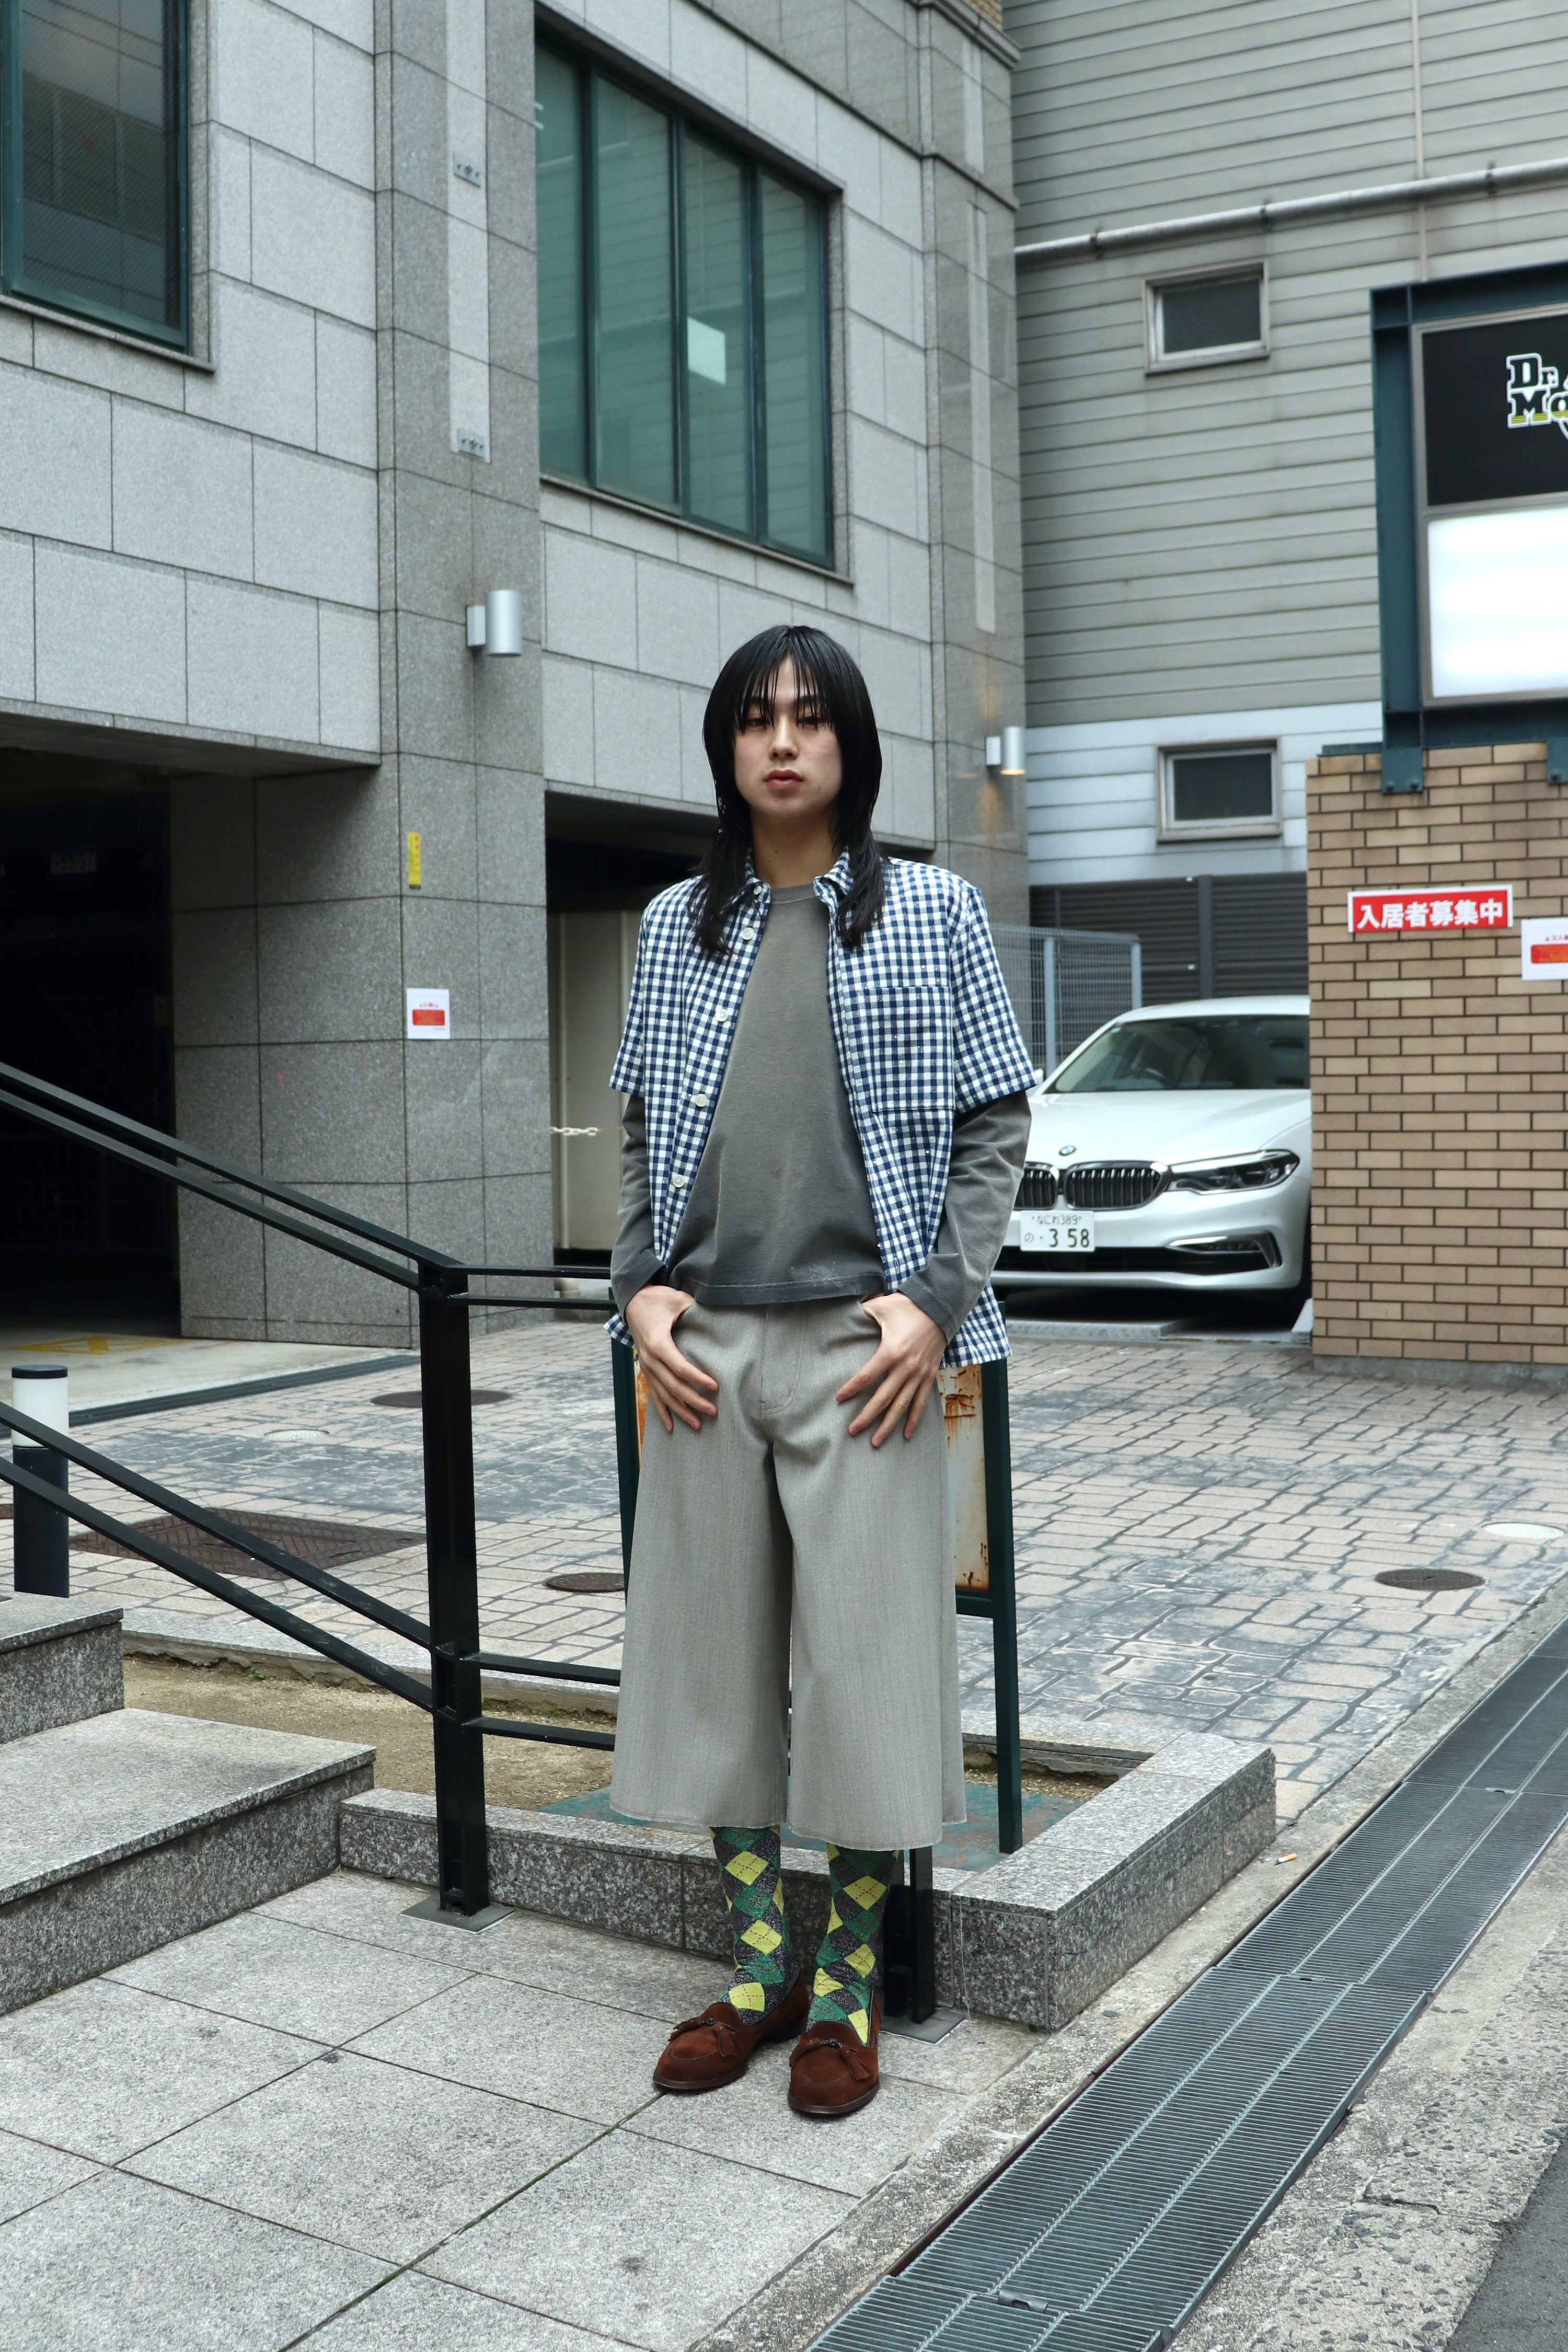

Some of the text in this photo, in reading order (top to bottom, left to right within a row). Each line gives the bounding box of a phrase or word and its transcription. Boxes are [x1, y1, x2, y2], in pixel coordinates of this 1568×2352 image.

[1357, 898, 1503, 929] 入居者募集中
